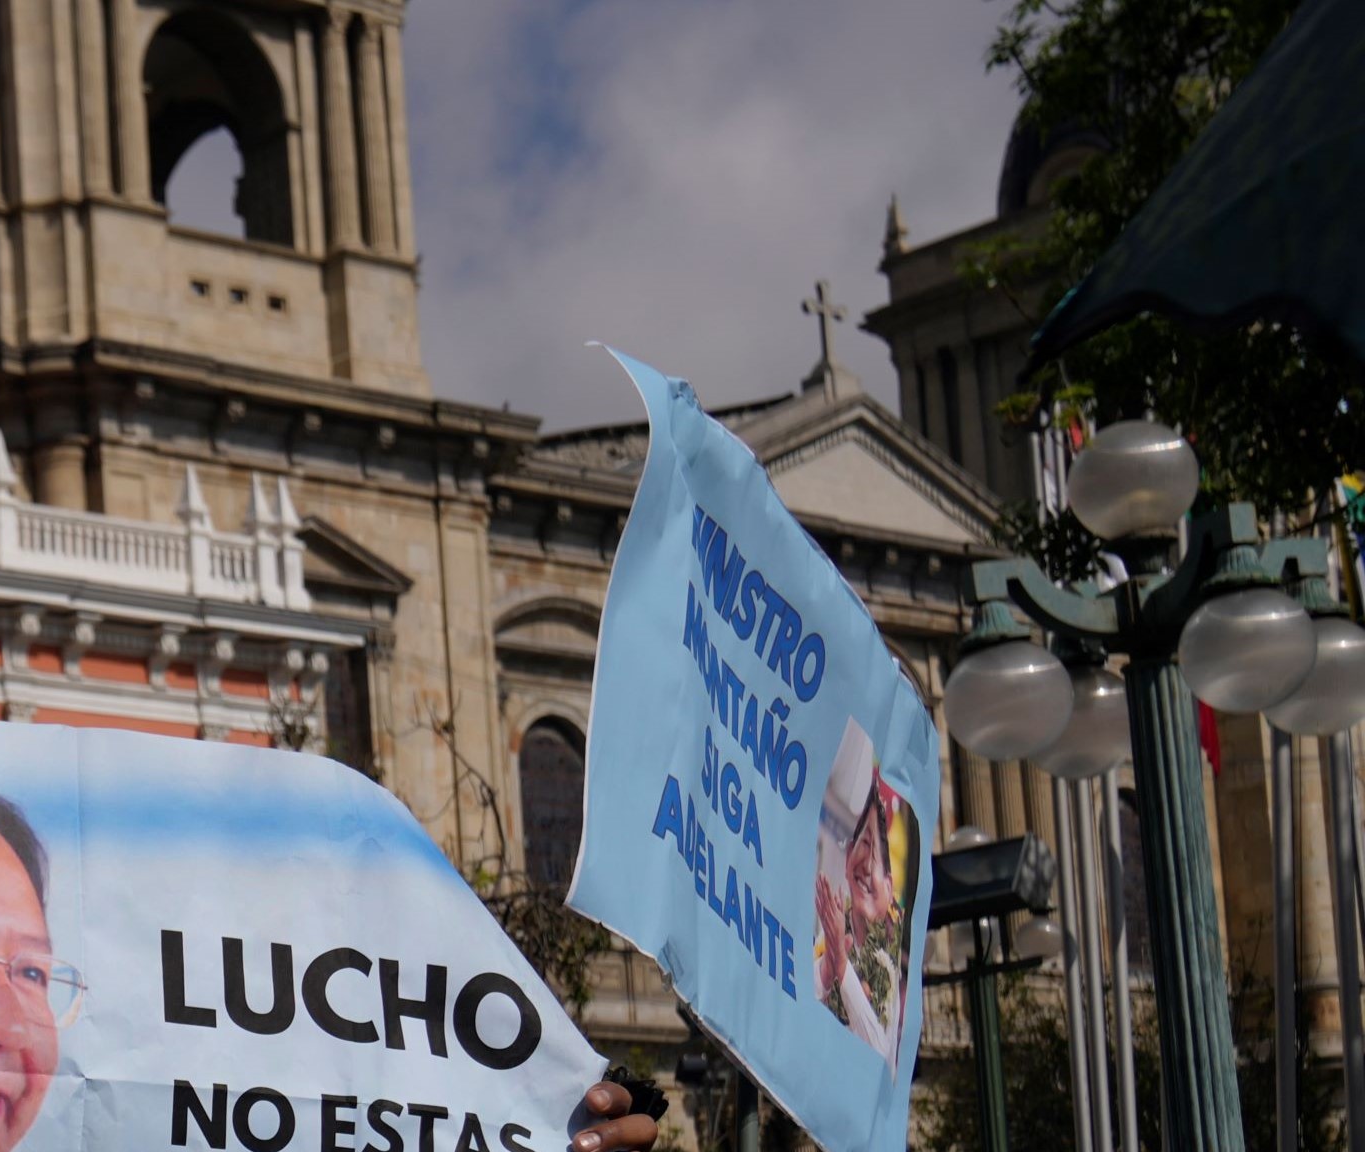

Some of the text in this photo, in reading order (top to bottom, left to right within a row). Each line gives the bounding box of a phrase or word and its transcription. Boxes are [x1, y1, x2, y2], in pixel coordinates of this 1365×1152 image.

[701, 725, 764, 869] SIGA
[651, 774, 797, 1002] ADELANTE
[160, 929, 543, 1071] LUCHO
